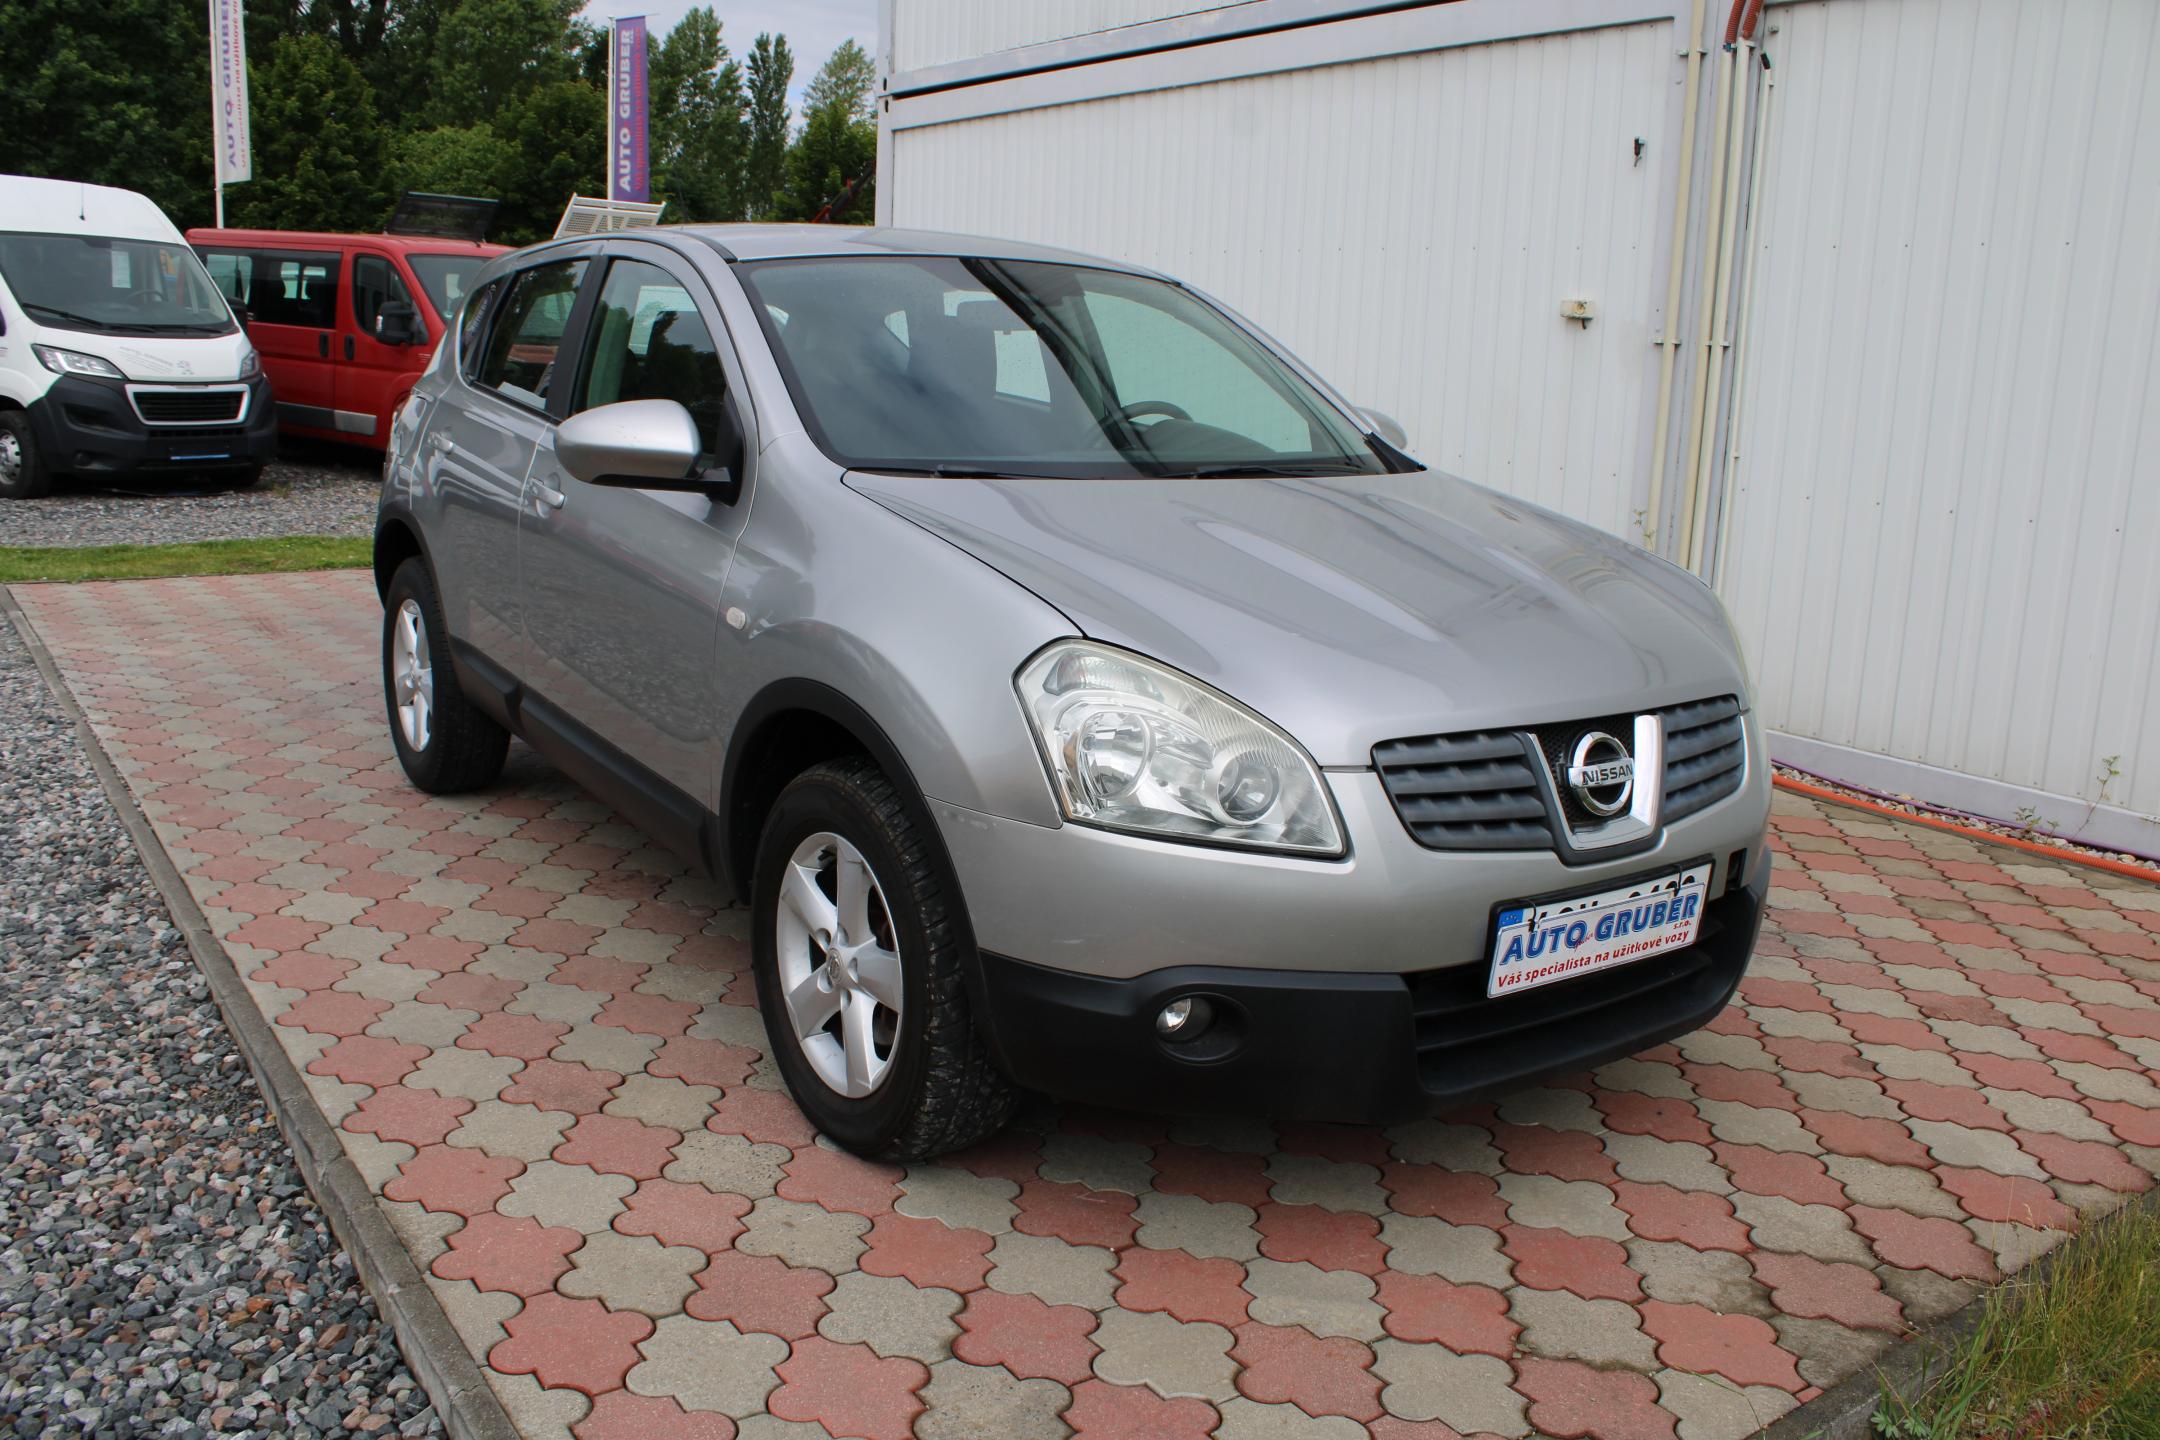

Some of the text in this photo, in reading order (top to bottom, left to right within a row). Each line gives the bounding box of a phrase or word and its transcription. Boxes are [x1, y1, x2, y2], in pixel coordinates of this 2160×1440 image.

[225, 101, 236, 167] AUTO
[619, 29, 631, 192] AUTO GRUBER
[1582, 763, 1633, 786] NISSAN
[1499, 920, 1588, 966] AUTO
[1595, 893, 1699, 941] GRUBER
[1673, 920, 1692, 930] s.r.o.
[1498, 930, 1690, 988] Váš specialista na užitkové vozy
